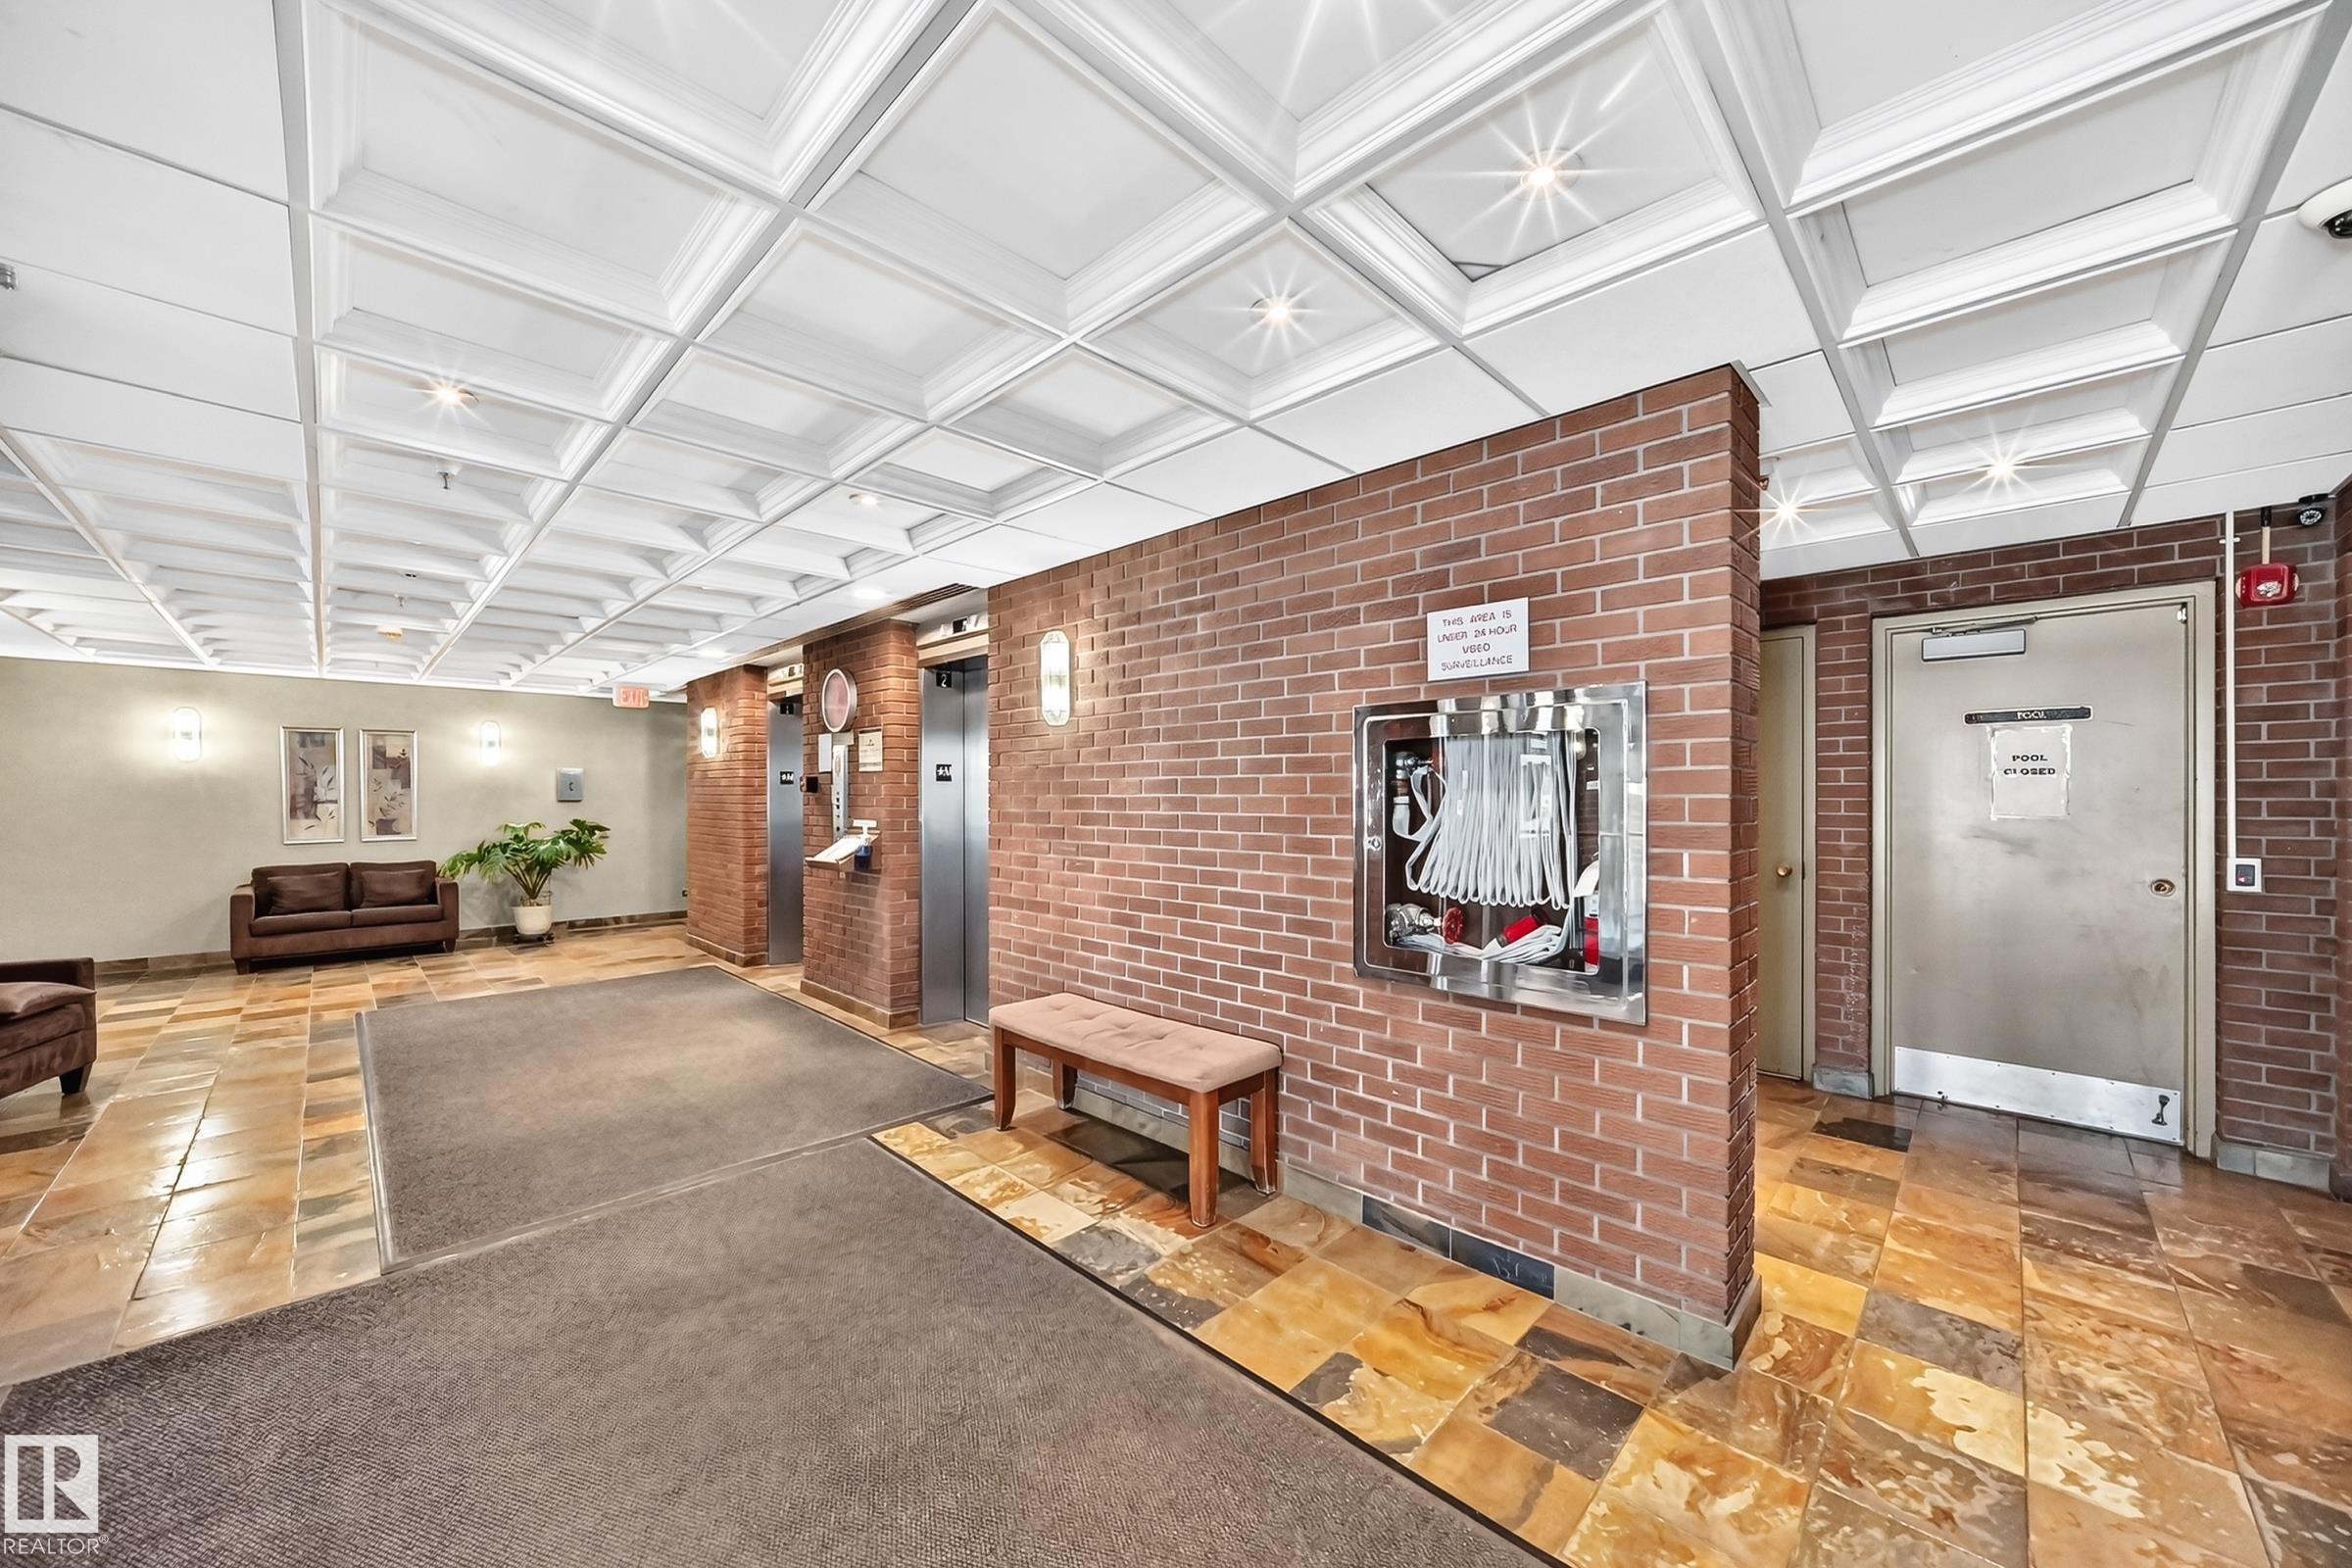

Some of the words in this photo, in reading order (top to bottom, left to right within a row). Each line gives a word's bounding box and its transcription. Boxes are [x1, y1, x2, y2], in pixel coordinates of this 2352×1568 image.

[1470, 612, 1495, 623] AREA
[1502, 610, 1512, 619] IS
[1489, 624, 1517, 636] HOUR
